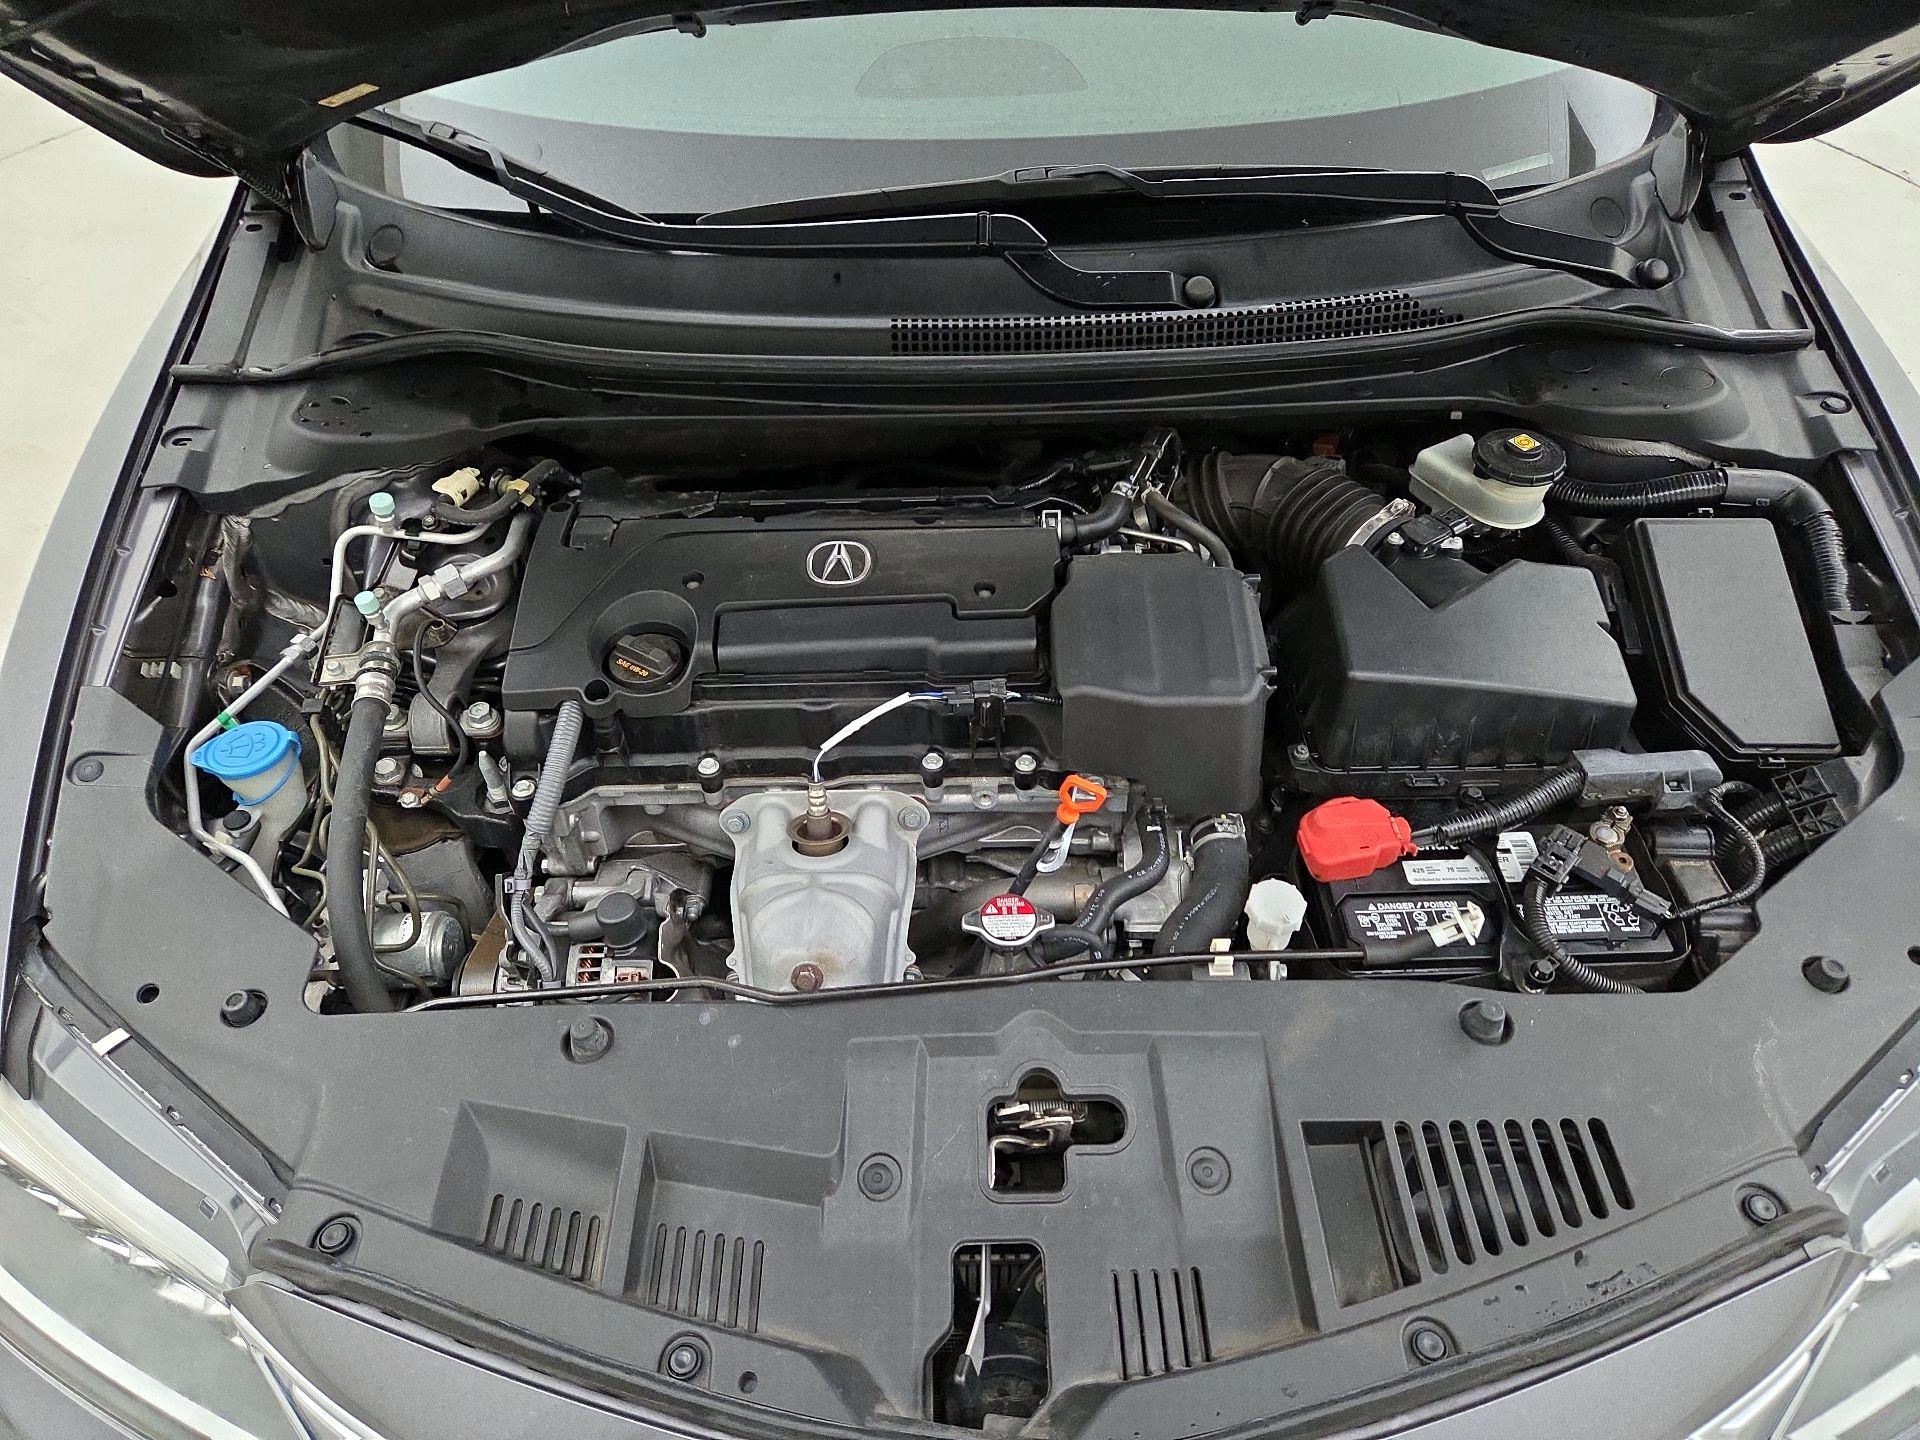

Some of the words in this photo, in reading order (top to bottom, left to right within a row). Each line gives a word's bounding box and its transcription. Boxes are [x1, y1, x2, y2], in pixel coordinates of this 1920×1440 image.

[616, 658, 631, 668] SAE
[1377, 902, 1415, 910] DANGER
[1423, 901, 1458, 909] POISON
